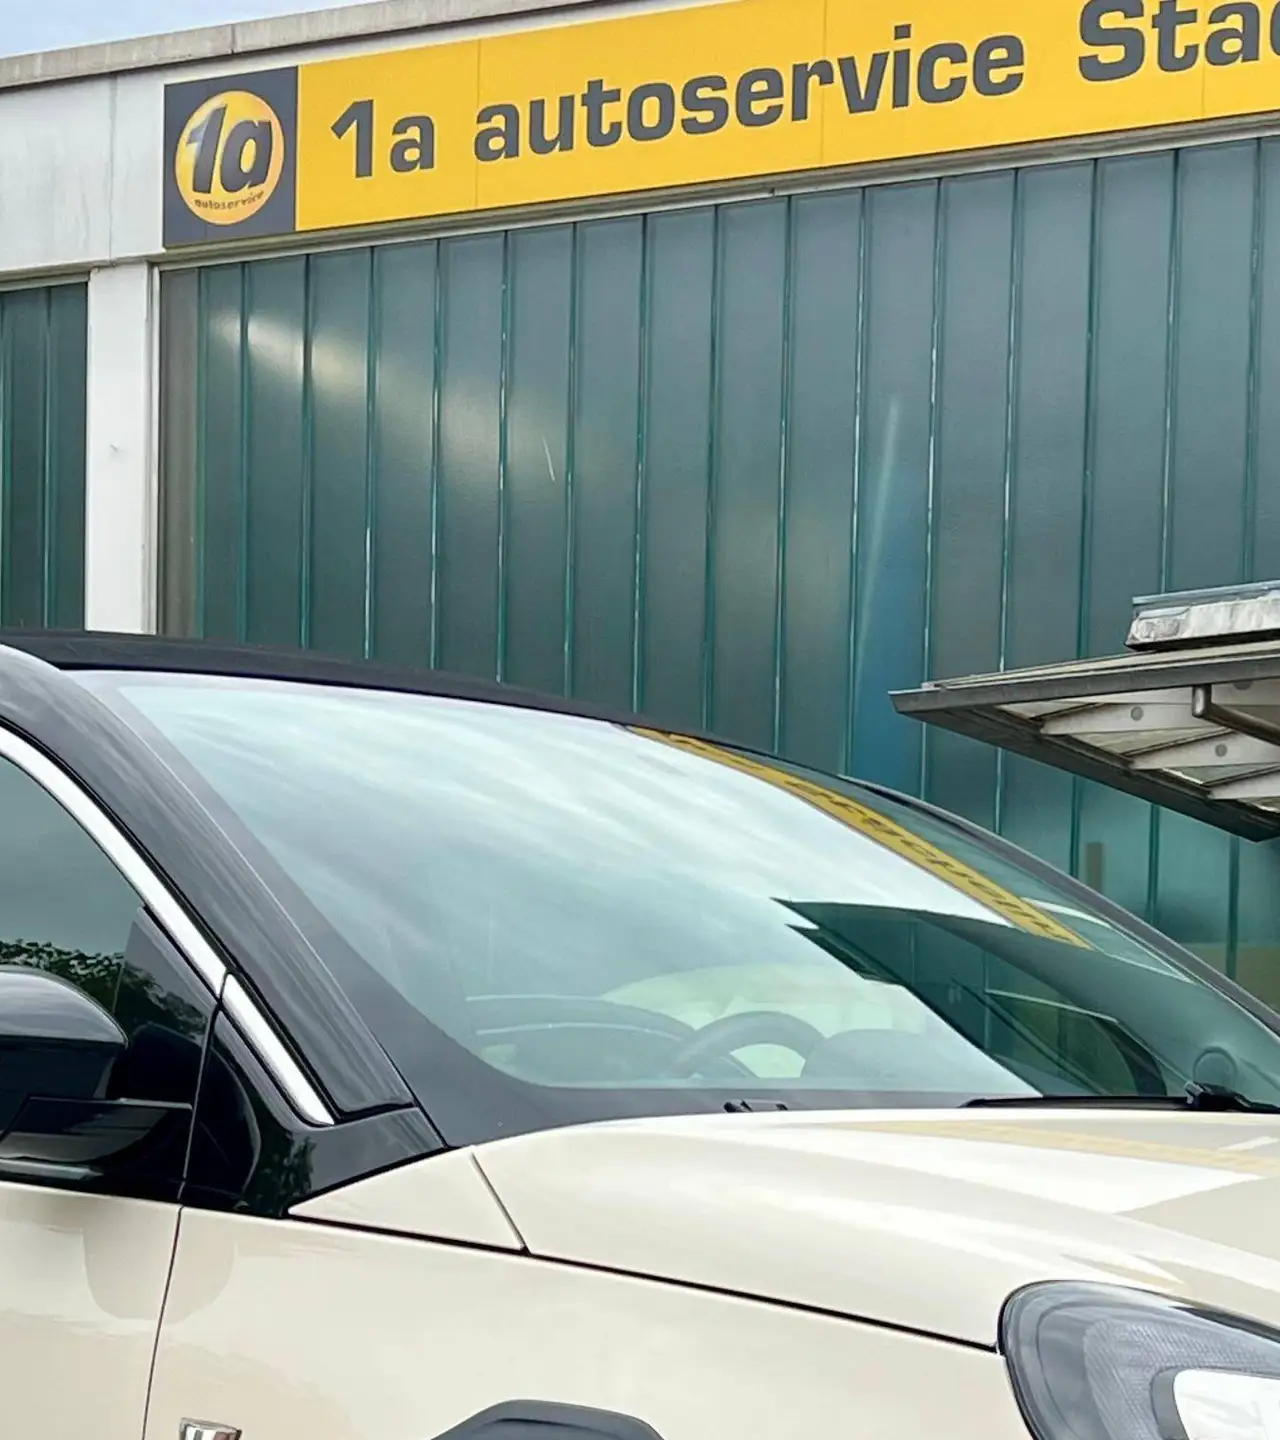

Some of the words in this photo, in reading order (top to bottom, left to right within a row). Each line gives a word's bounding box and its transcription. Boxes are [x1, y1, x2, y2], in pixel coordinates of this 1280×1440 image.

[186, 104, 273, 194] 1a
[331, 98, 434, 179] 1a
[474, 24, 1024, 162] autoservice
